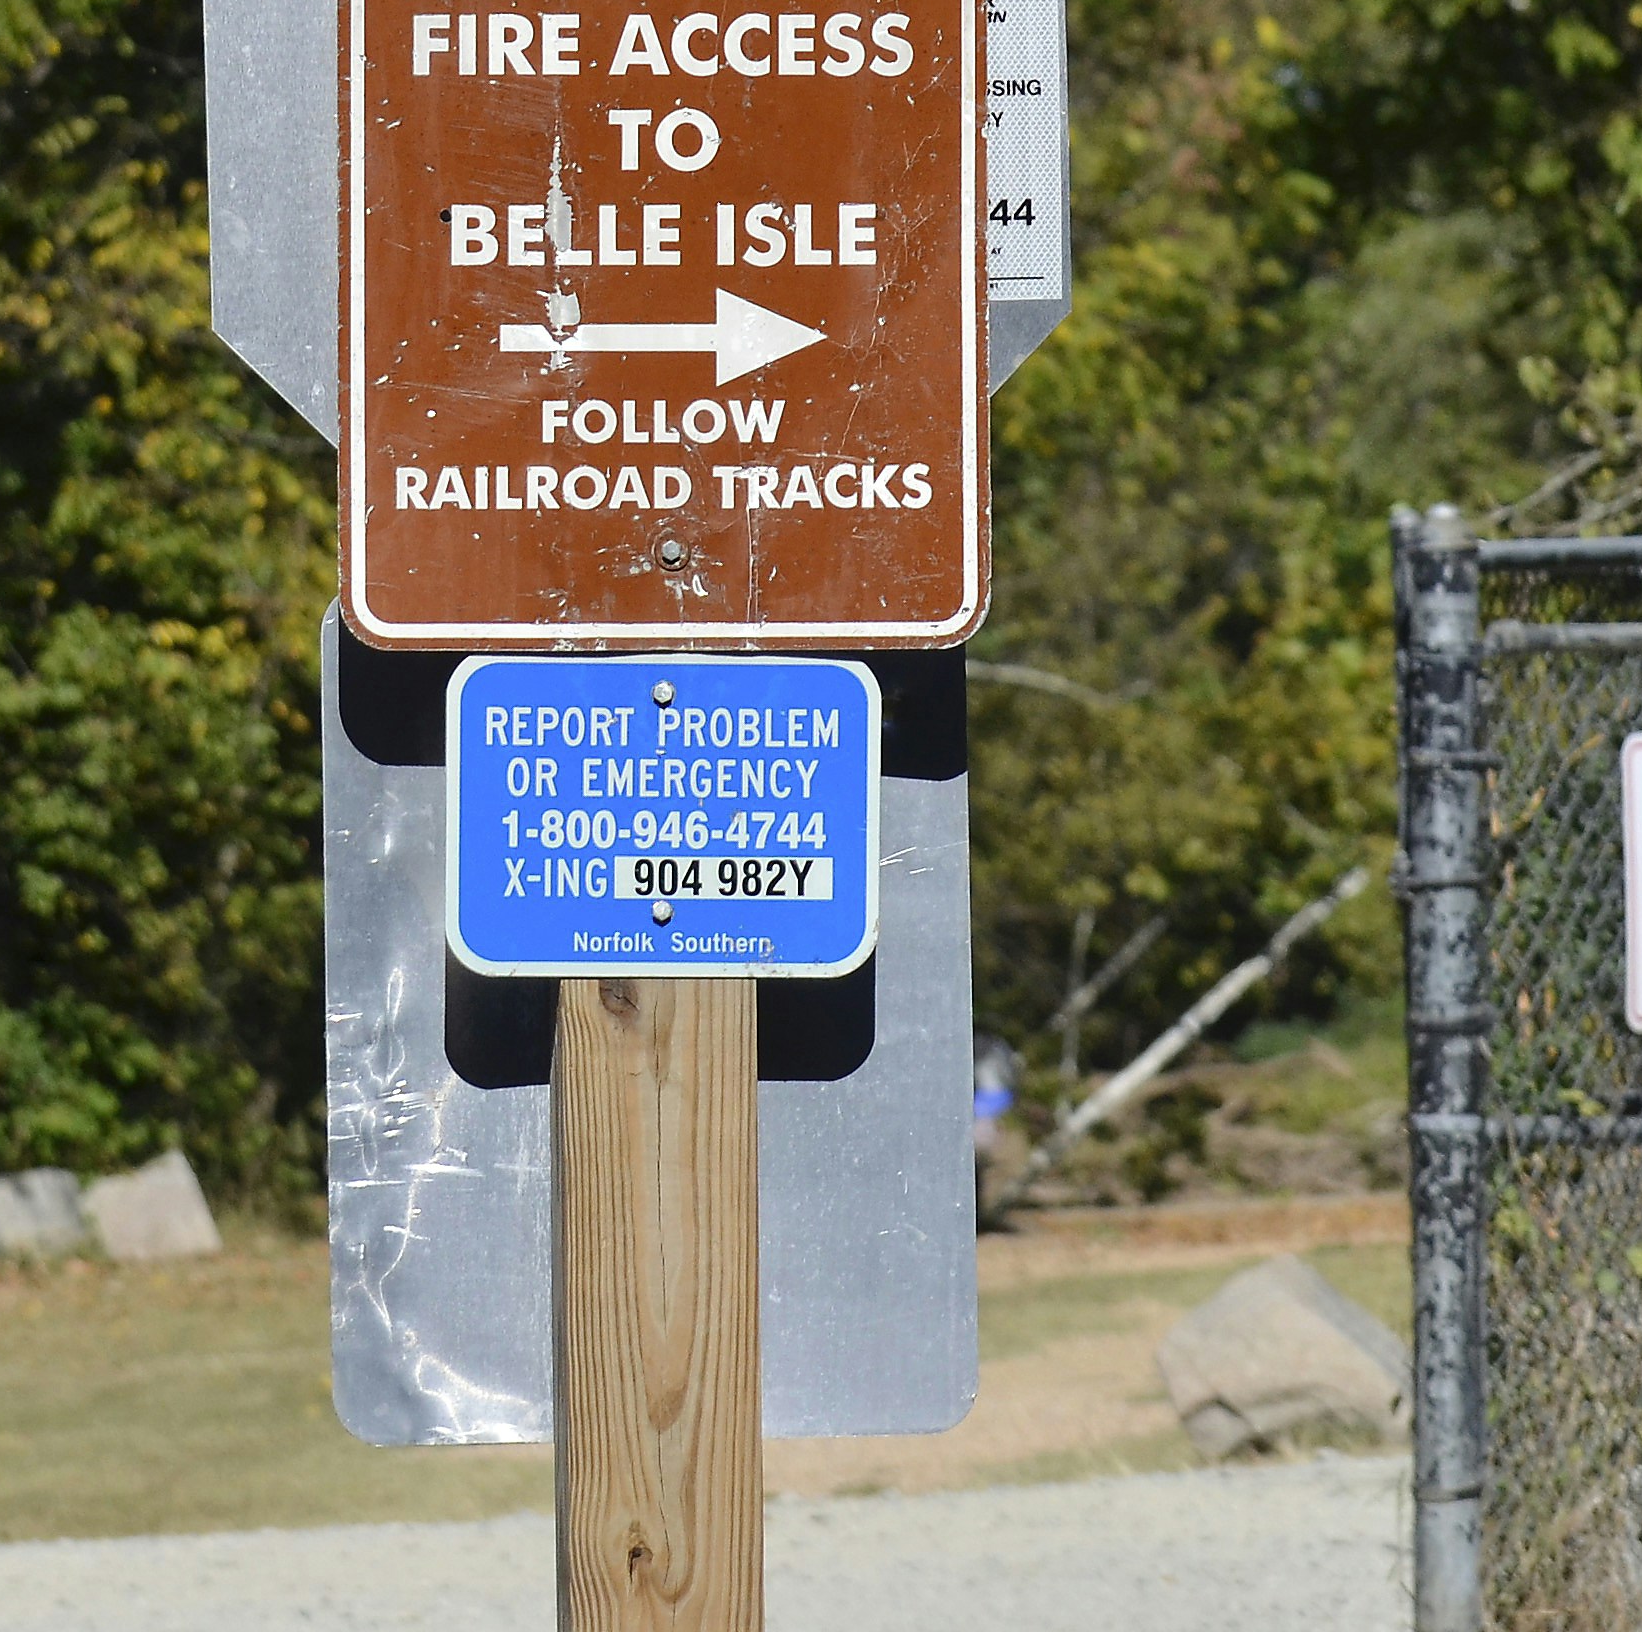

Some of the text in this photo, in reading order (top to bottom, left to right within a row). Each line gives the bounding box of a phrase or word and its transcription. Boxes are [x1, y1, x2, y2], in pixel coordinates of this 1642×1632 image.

[412, 12, 914, 77] FIRE ACCESS
[608, 106, 722, 172] TO
[450, 203, 878, 267] BELLE ISLE
[541, 398, 786, 445] FOLLOW
[394, 463, 934, 511] RAILROAD TRACKS
[485, 706, 840, 748] REPORT PROBLEM
[506, 757, 820, 799] OR EMERGENCY
[501, 809, 827, 850] 1-800-946-4744
[503, 858, 815, 898] X-ING 904 982Y
[573, 931, 773, 954] Norfolk Southern
